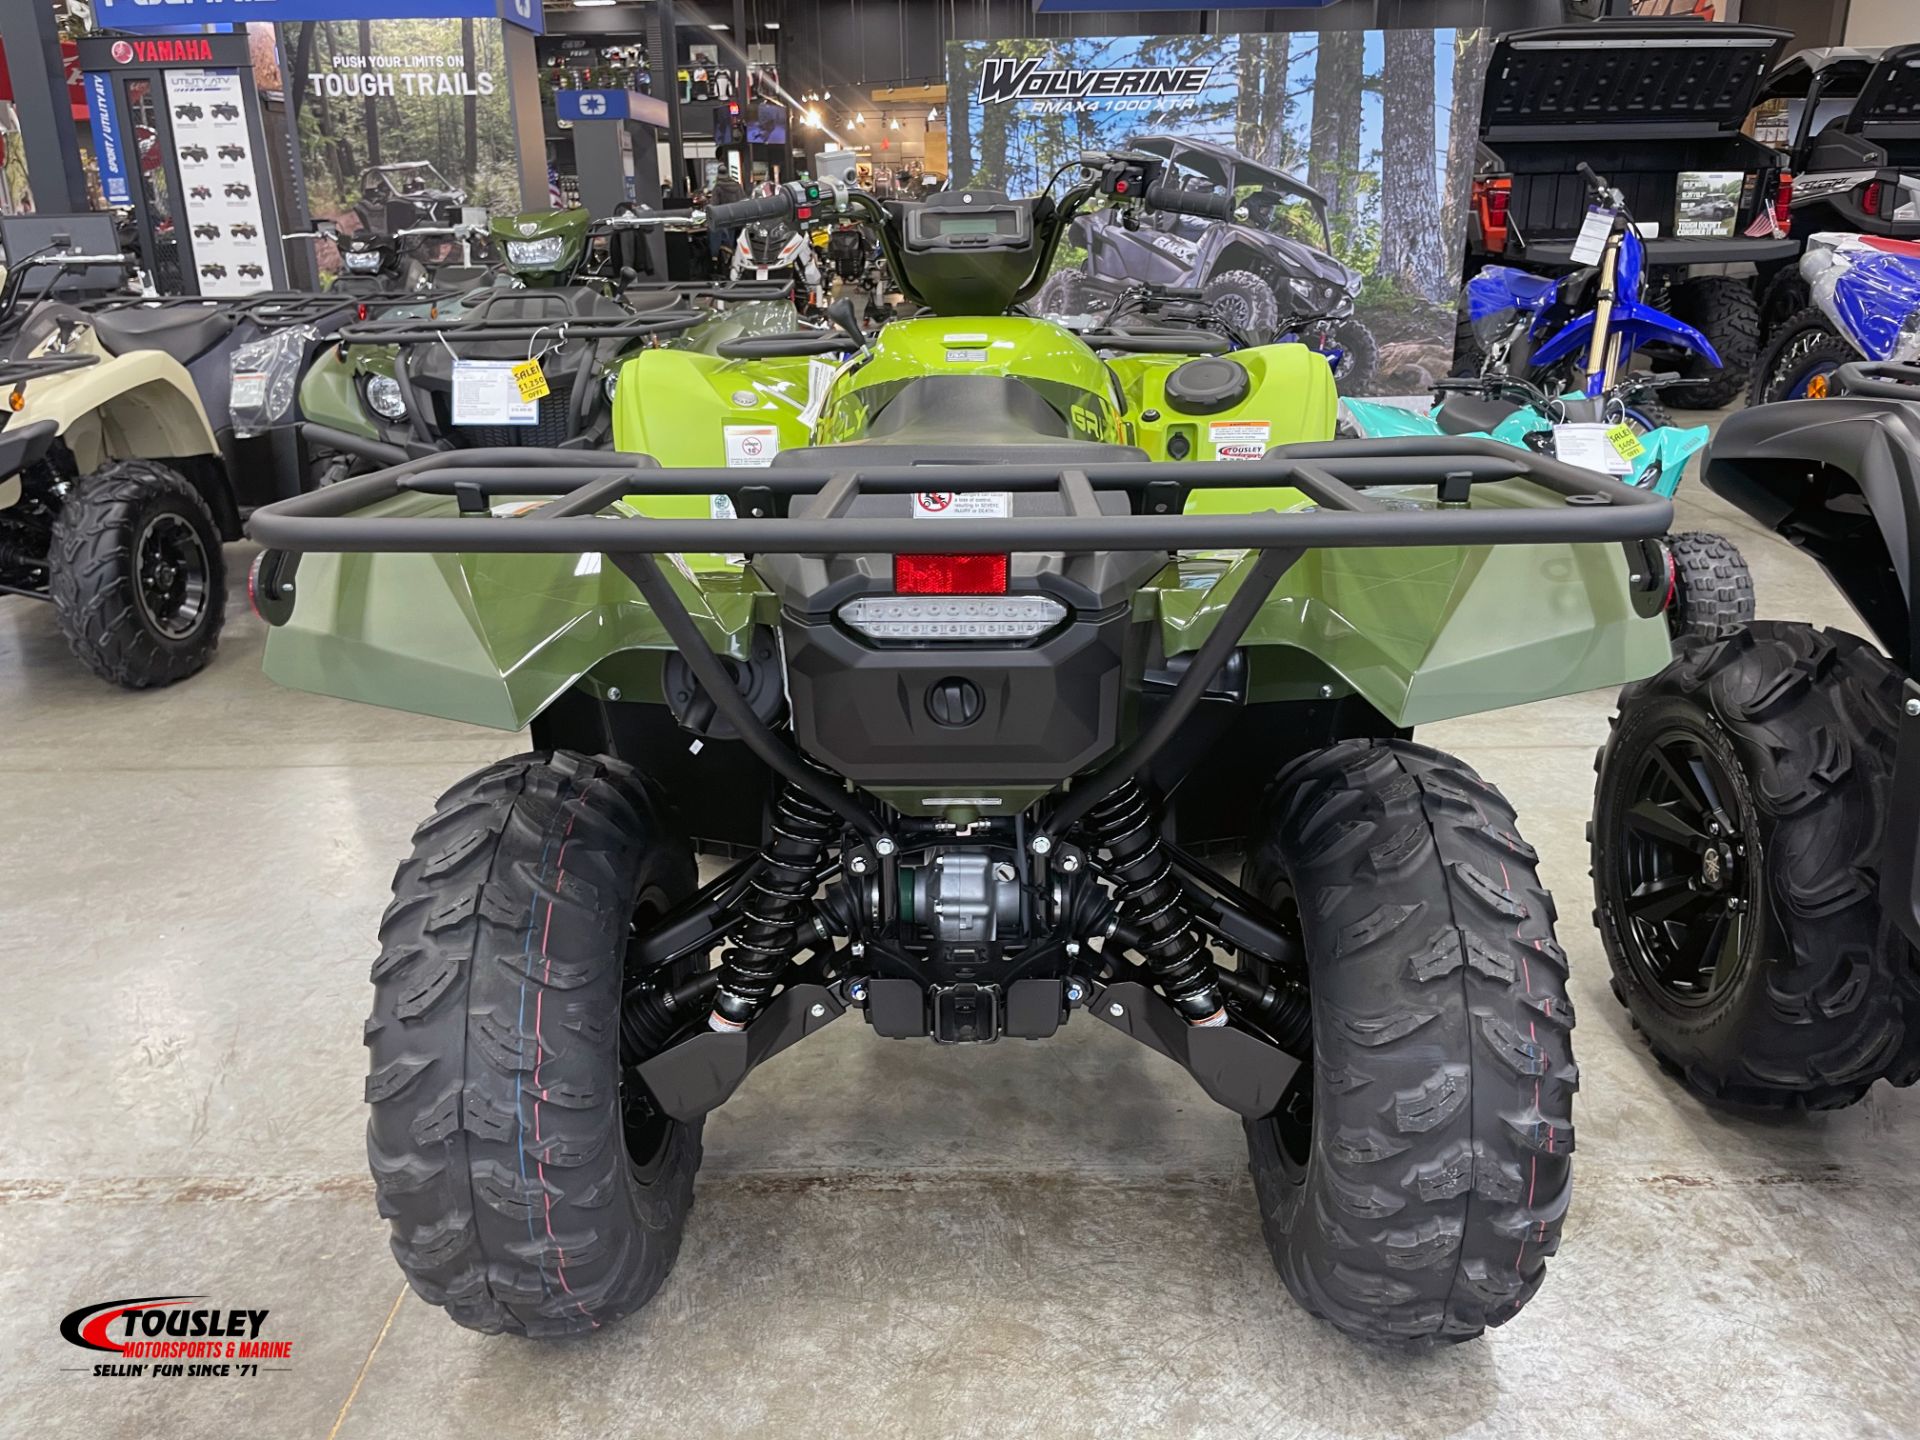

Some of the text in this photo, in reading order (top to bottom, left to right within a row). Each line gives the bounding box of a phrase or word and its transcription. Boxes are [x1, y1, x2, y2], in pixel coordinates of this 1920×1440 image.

[133, 39, 213, 62] YAMAHA
[333, 55, 464, 68] PUSH YOUR LIMITS ON
[93, 74, 105, 96] ATV
[308, 72, 494, 97] TOUGH TRAILS
[977, 57, 1213, 104] WOLVERINE
[97, 95, 112, 134] UTILITY
[1104, 99, 1152, 112] 1000
[104, 140, 119, 174] SPORT
[513, 365, 541, 382] SALE!
